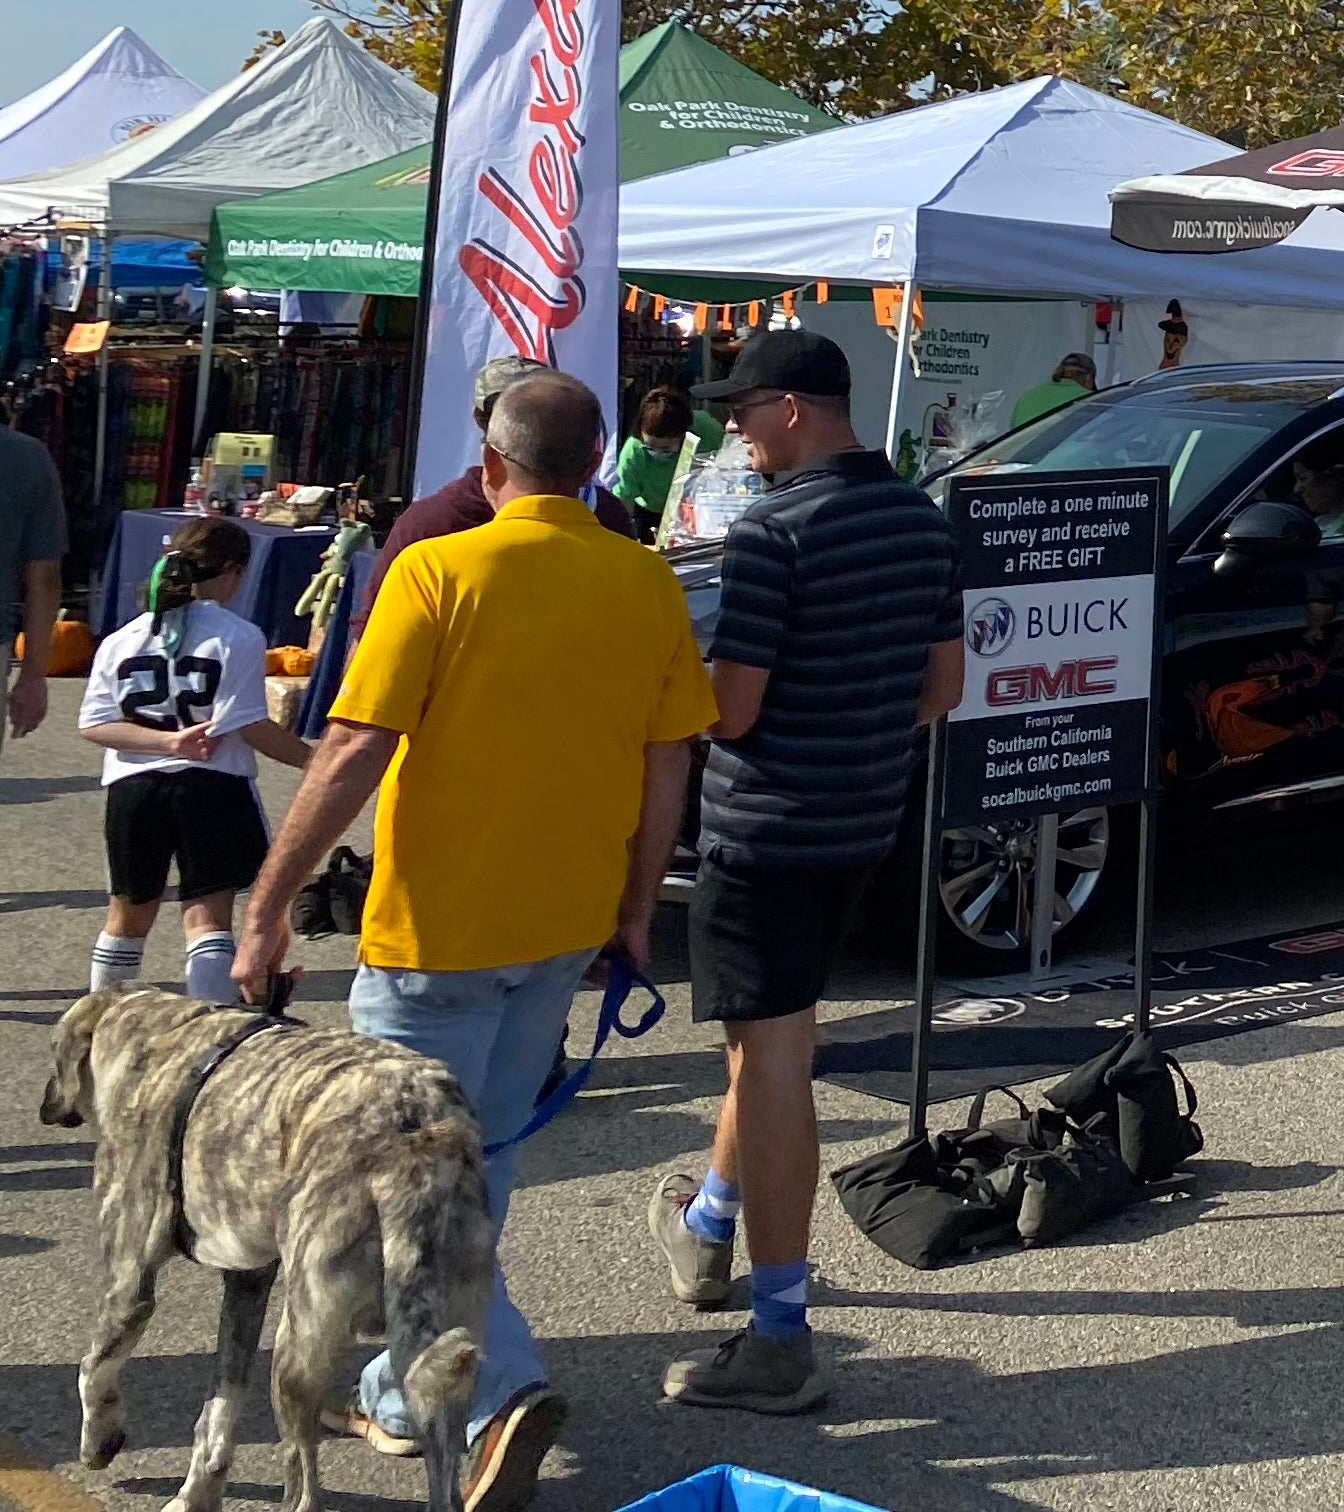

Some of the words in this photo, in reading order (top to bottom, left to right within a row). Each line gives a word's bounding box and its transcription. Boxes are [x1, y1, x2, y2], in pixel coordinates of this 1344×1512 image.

[628, 102, 672, 113] Oak
[674, 101, 721, 112] Park
[724, 102, 810, 123] Dentistry
[669, 110, 699, 121] for
[708, 110, 786, 126] Children
[659, 120, 675, 130] &
[679, 119, 808, 137] Orthodontics
[268, 239, 313, 261] Dentistry
[313, 239, 329, 257] for
[329, 239, 373, 258] Children
[920, 327, 938, 342] ark
[940, 328, 990, 349] Dentistry
[926, 343, 970, 359] Children
[969, 496, 1047, 521] Complete
[1050, 500, 1060, 514] a
[1064, 497, 1094, 513] one
[1098, 490, 1150, 511] minute
[982, 526, 1037, 548] survey
[1041, 521, 1071, 543] and
[1075, 517, 1131, 539] receive
[1004, 558, 1014, 573] a
[1019, 549, 1063, 572] FREE
[1067, 546, 1105, 568] GIFT
[1027, 598, 1129, 639] BUICK
[984, 654, 1119, 707] GMC
[1025, 714, 1050, 729] From
[1052, 711, 1075, 729] your
[987, 733, 1047, 755] Southern
[1051, 725, 1112, 747] California
[985, 756, 1024, 779] Buick
[1027, 751, 1059, 773] GMC
[1062, 748, 1111, 771] Dealers
[981, 775, 1112, 810] socalbuickgmc.com
